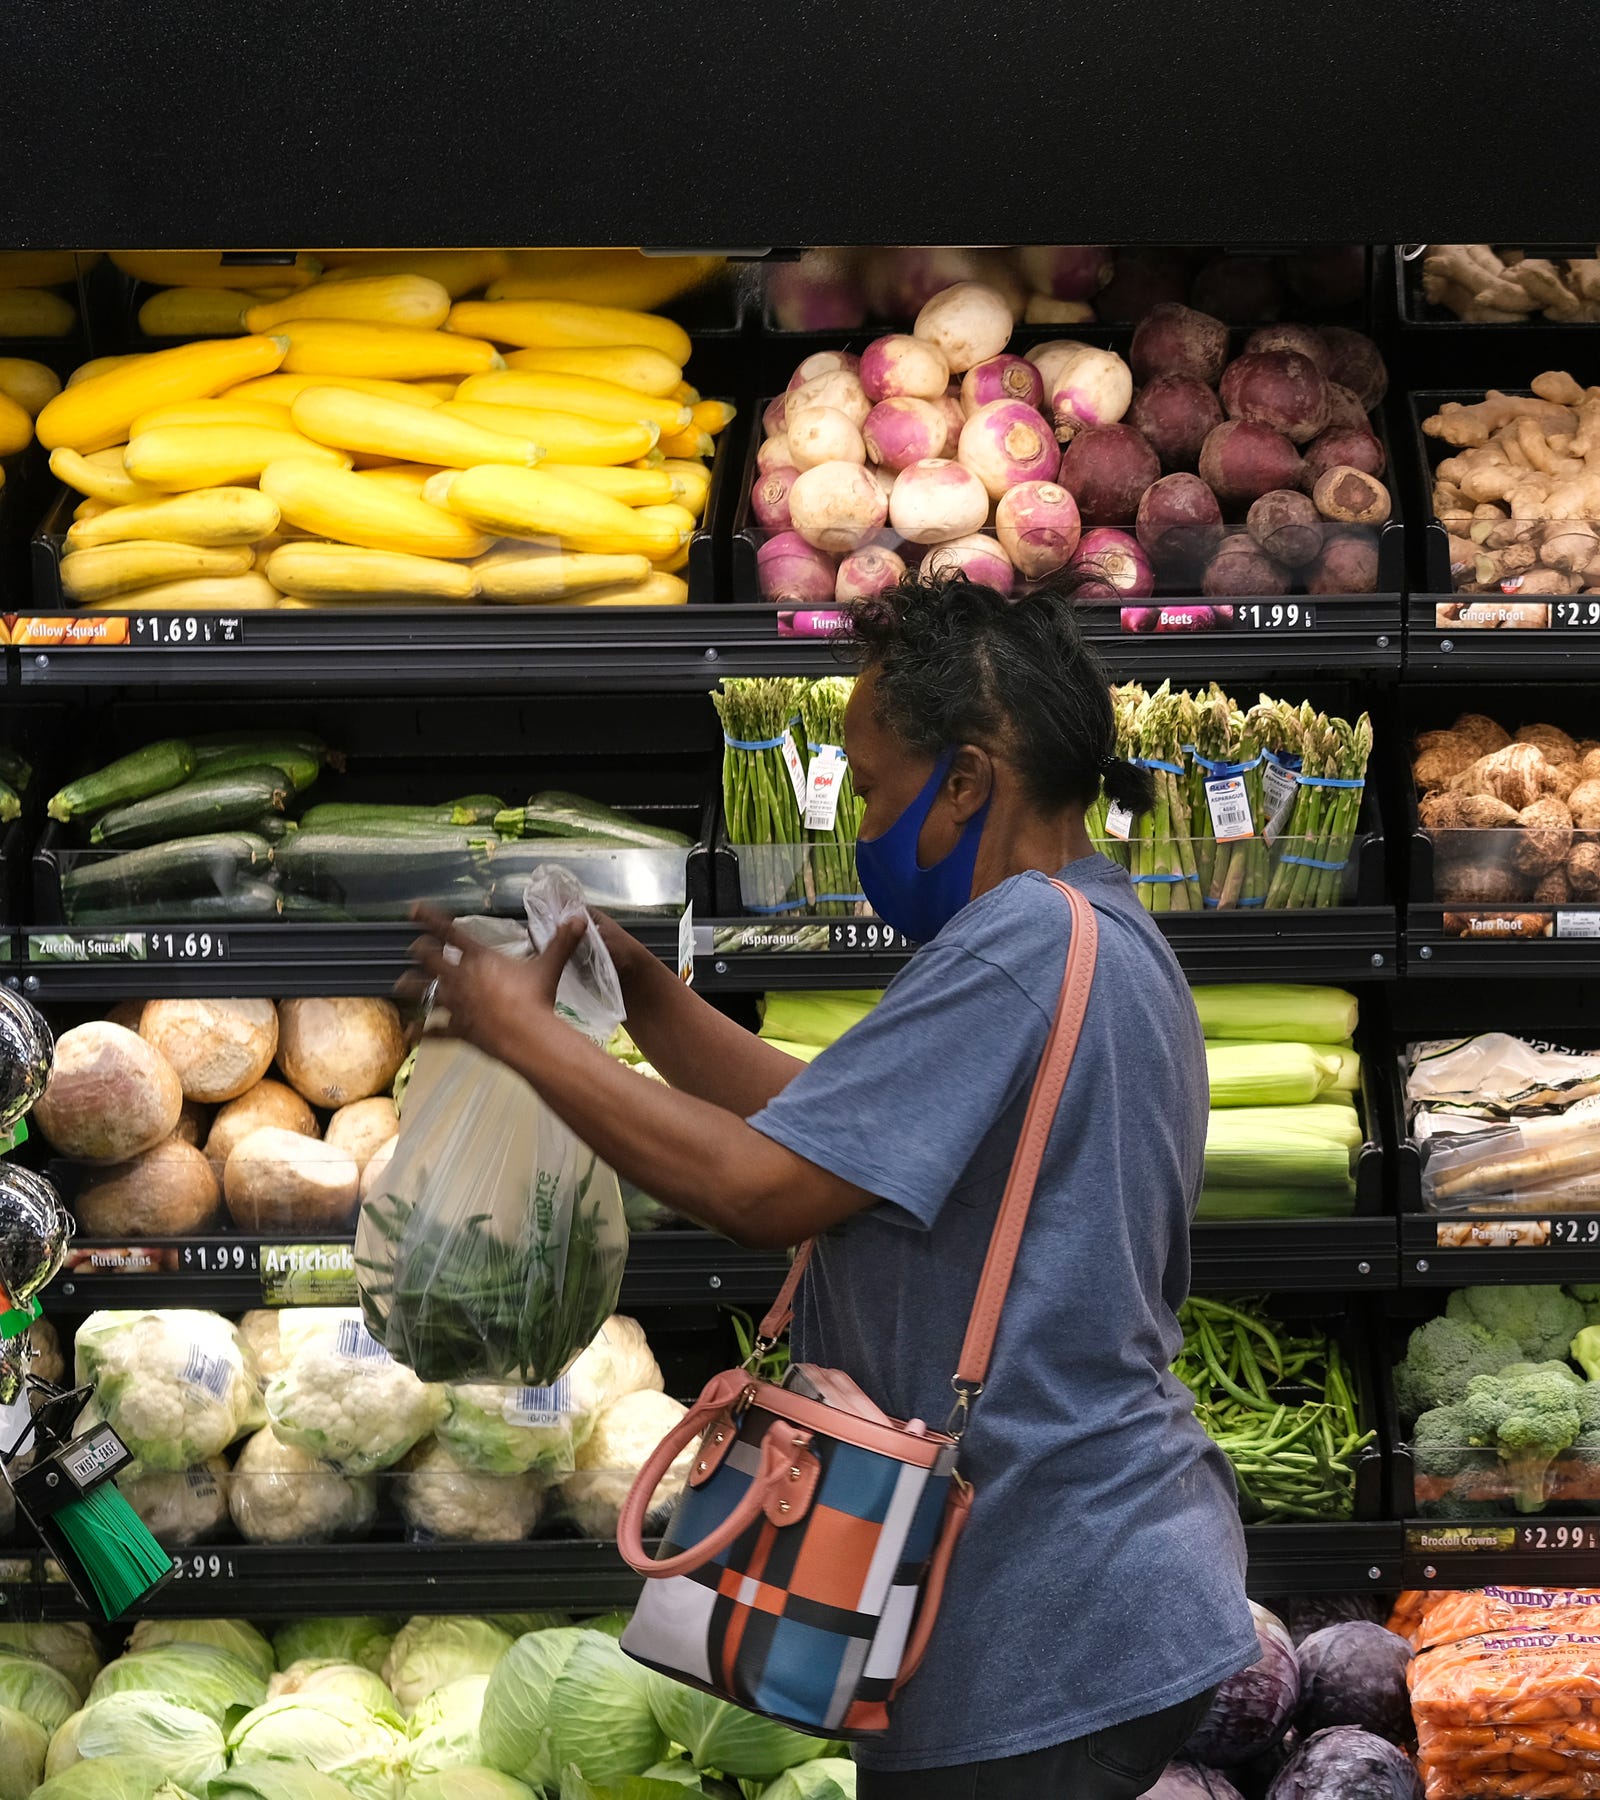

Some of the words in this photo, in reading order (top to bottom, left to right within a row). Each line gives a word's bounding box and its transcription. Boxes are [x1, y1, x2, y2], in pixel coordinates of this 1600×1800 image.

[1160, 613, 1193, 625] Beets
[1239, 604, 1299, 628] $1.99
[1459, 608, 1497, 623] Ginger
[1499, 609, 1525, 621] Root
[26, 624, 64, 637] Yellow
[66, 624, 107, 639] Squash
[136, 617, 198, 641] $1.69
[1470, 919, 1494, 930] Taro
[1496, 918, 1522, 929] Root
[741, 933, 799, 947] Asparagus
[835, 925, 894, 948] $3.99
[40, 939, 85, 953] Zucchini
[88, 939, 129, 955] Squash
[152, 933, 212, 958] $1.69
[1472, 1227, 1518, 1241] Parsnips
[91, 1254, 151, 1268] Rutabagas
[184, 1246, 245, 1271] $1.99
[74, 1455, 97, 1476] TWIST
[99, 1440, 118, 1461] EASE
[1420, 1534, 1459, 1546] Broccoli
[1461, 1534, 1497, 1546] Crowns
[1524, 1526, 1584, 1548] $2.99
